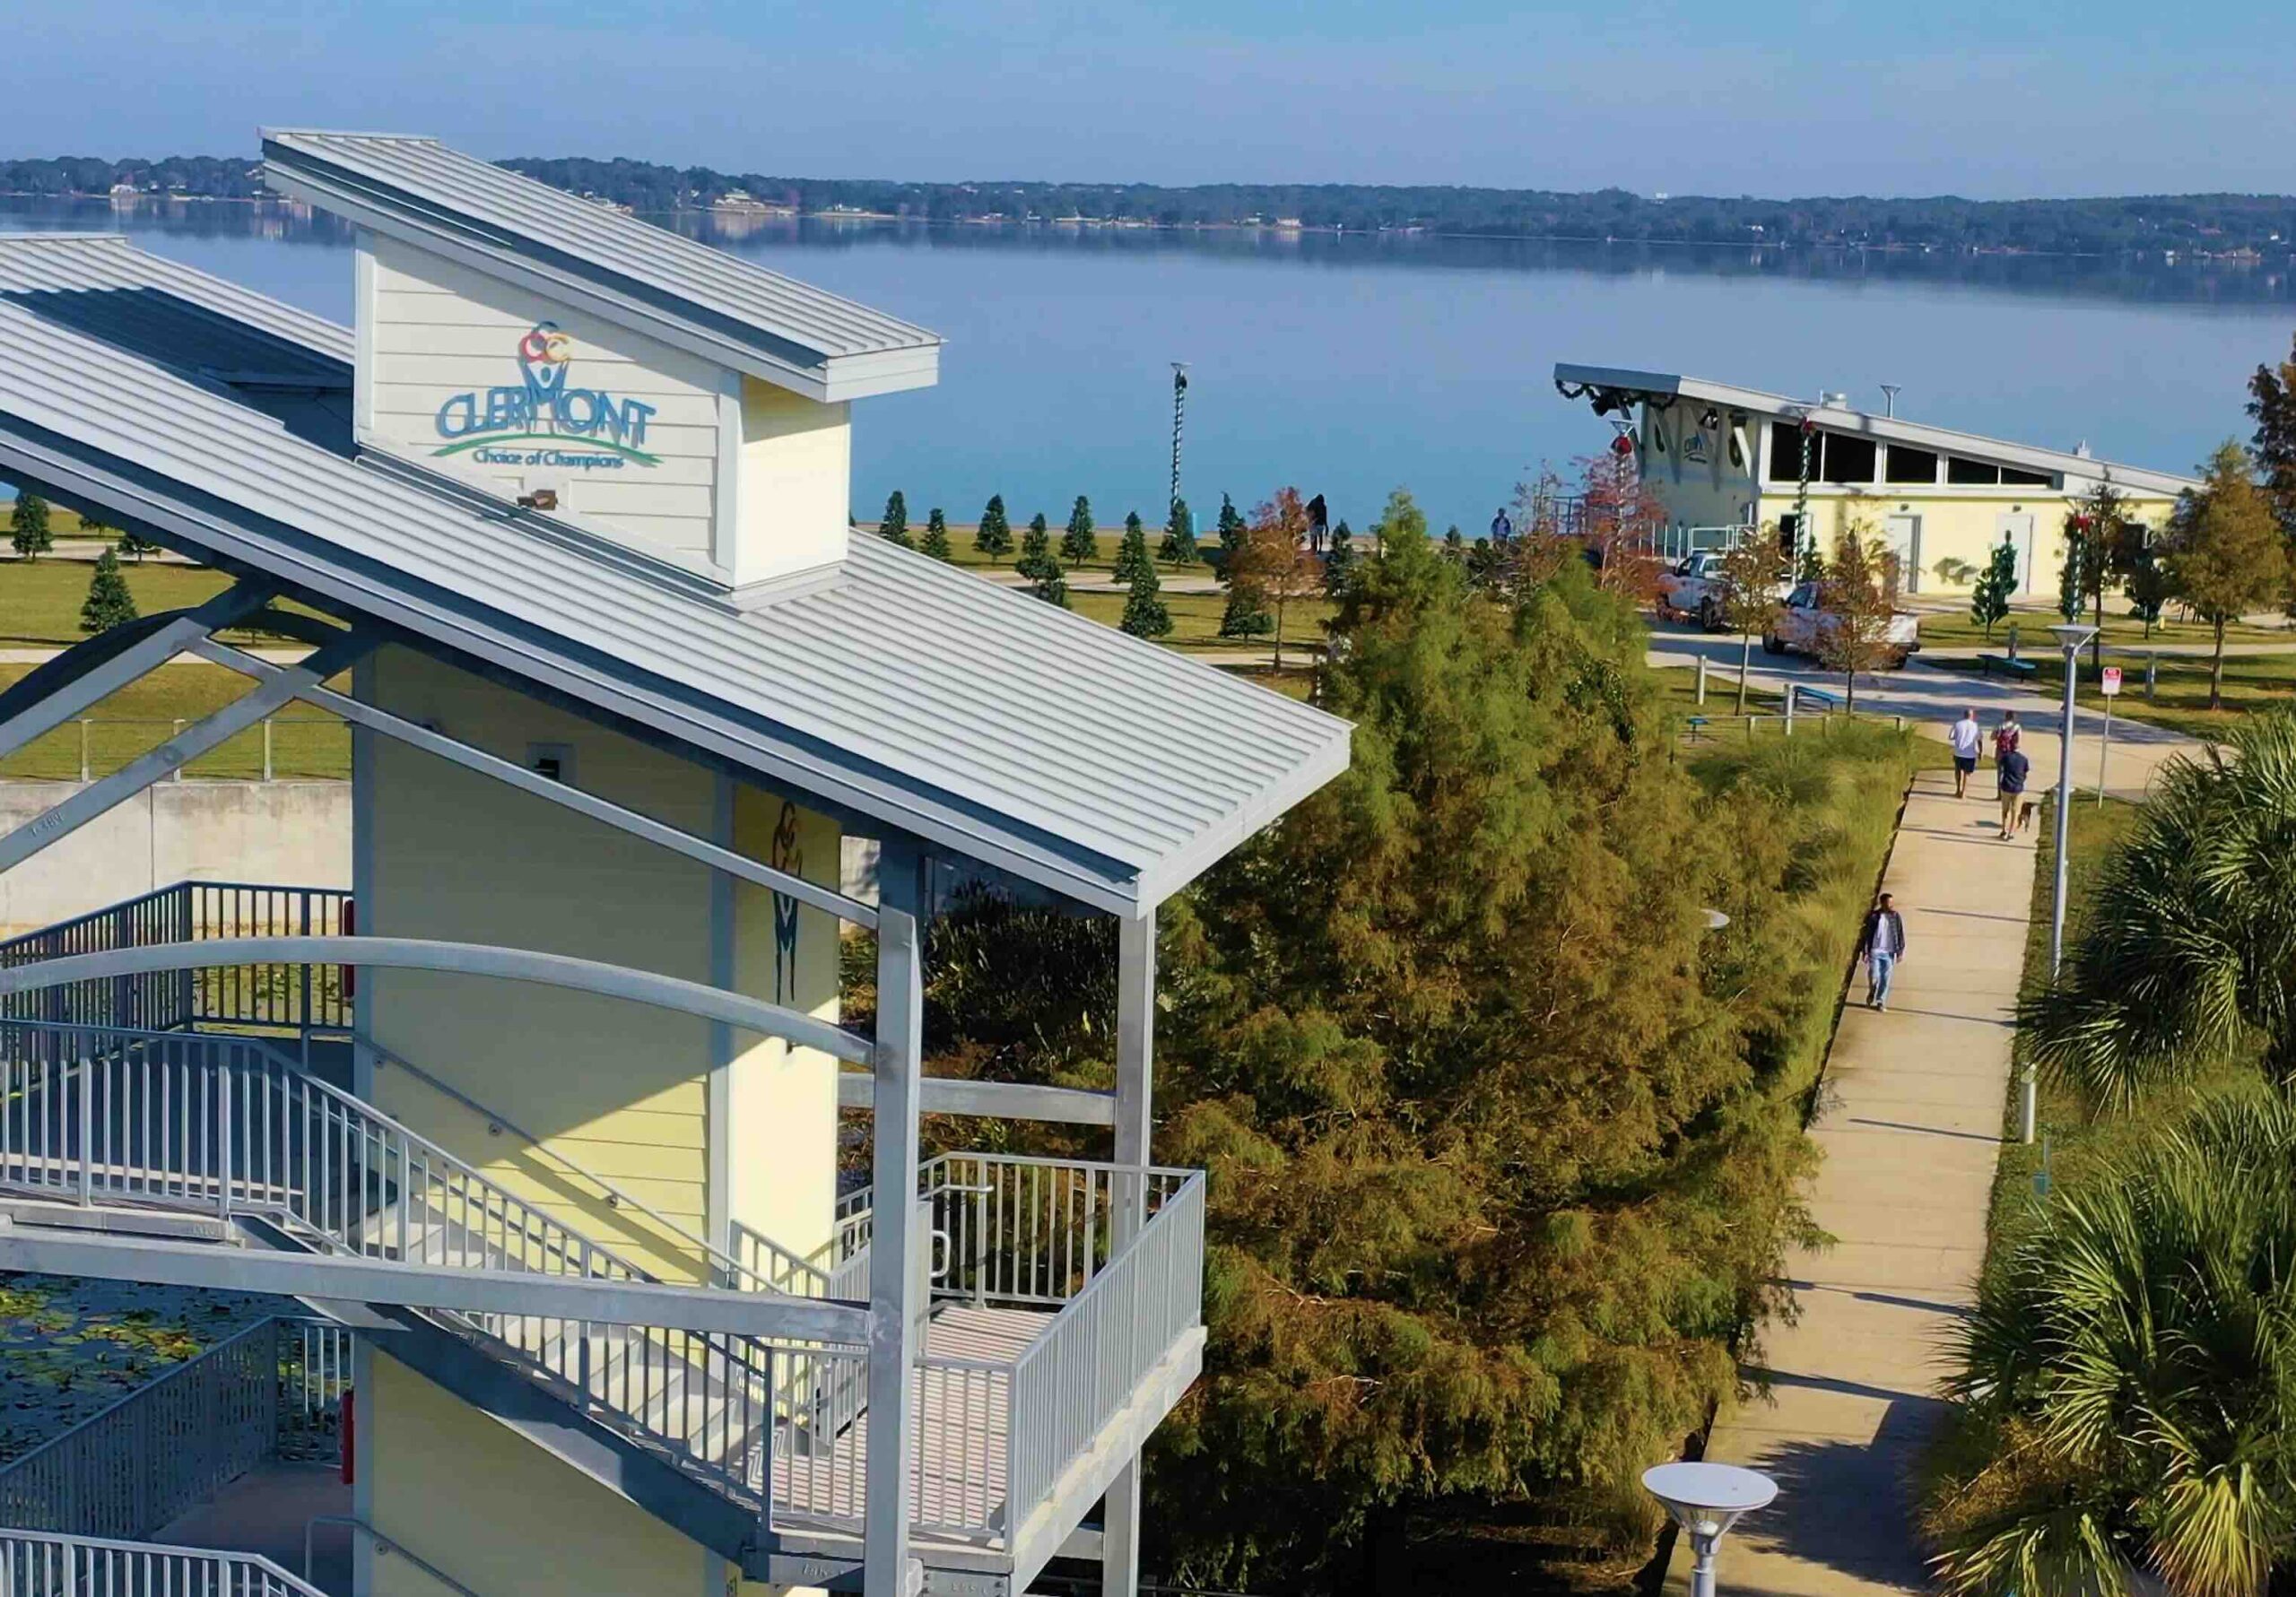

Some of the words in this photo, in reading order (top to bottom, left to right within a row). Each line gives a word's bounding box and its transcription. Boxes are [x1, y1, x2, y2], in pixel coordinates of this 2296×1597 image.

[436, 385, 657, 447] CLERMONT
[473, 449, 523, 464] Choice
[525, 450, 543, 465] of
[544, 449, 625, 471] Champions
